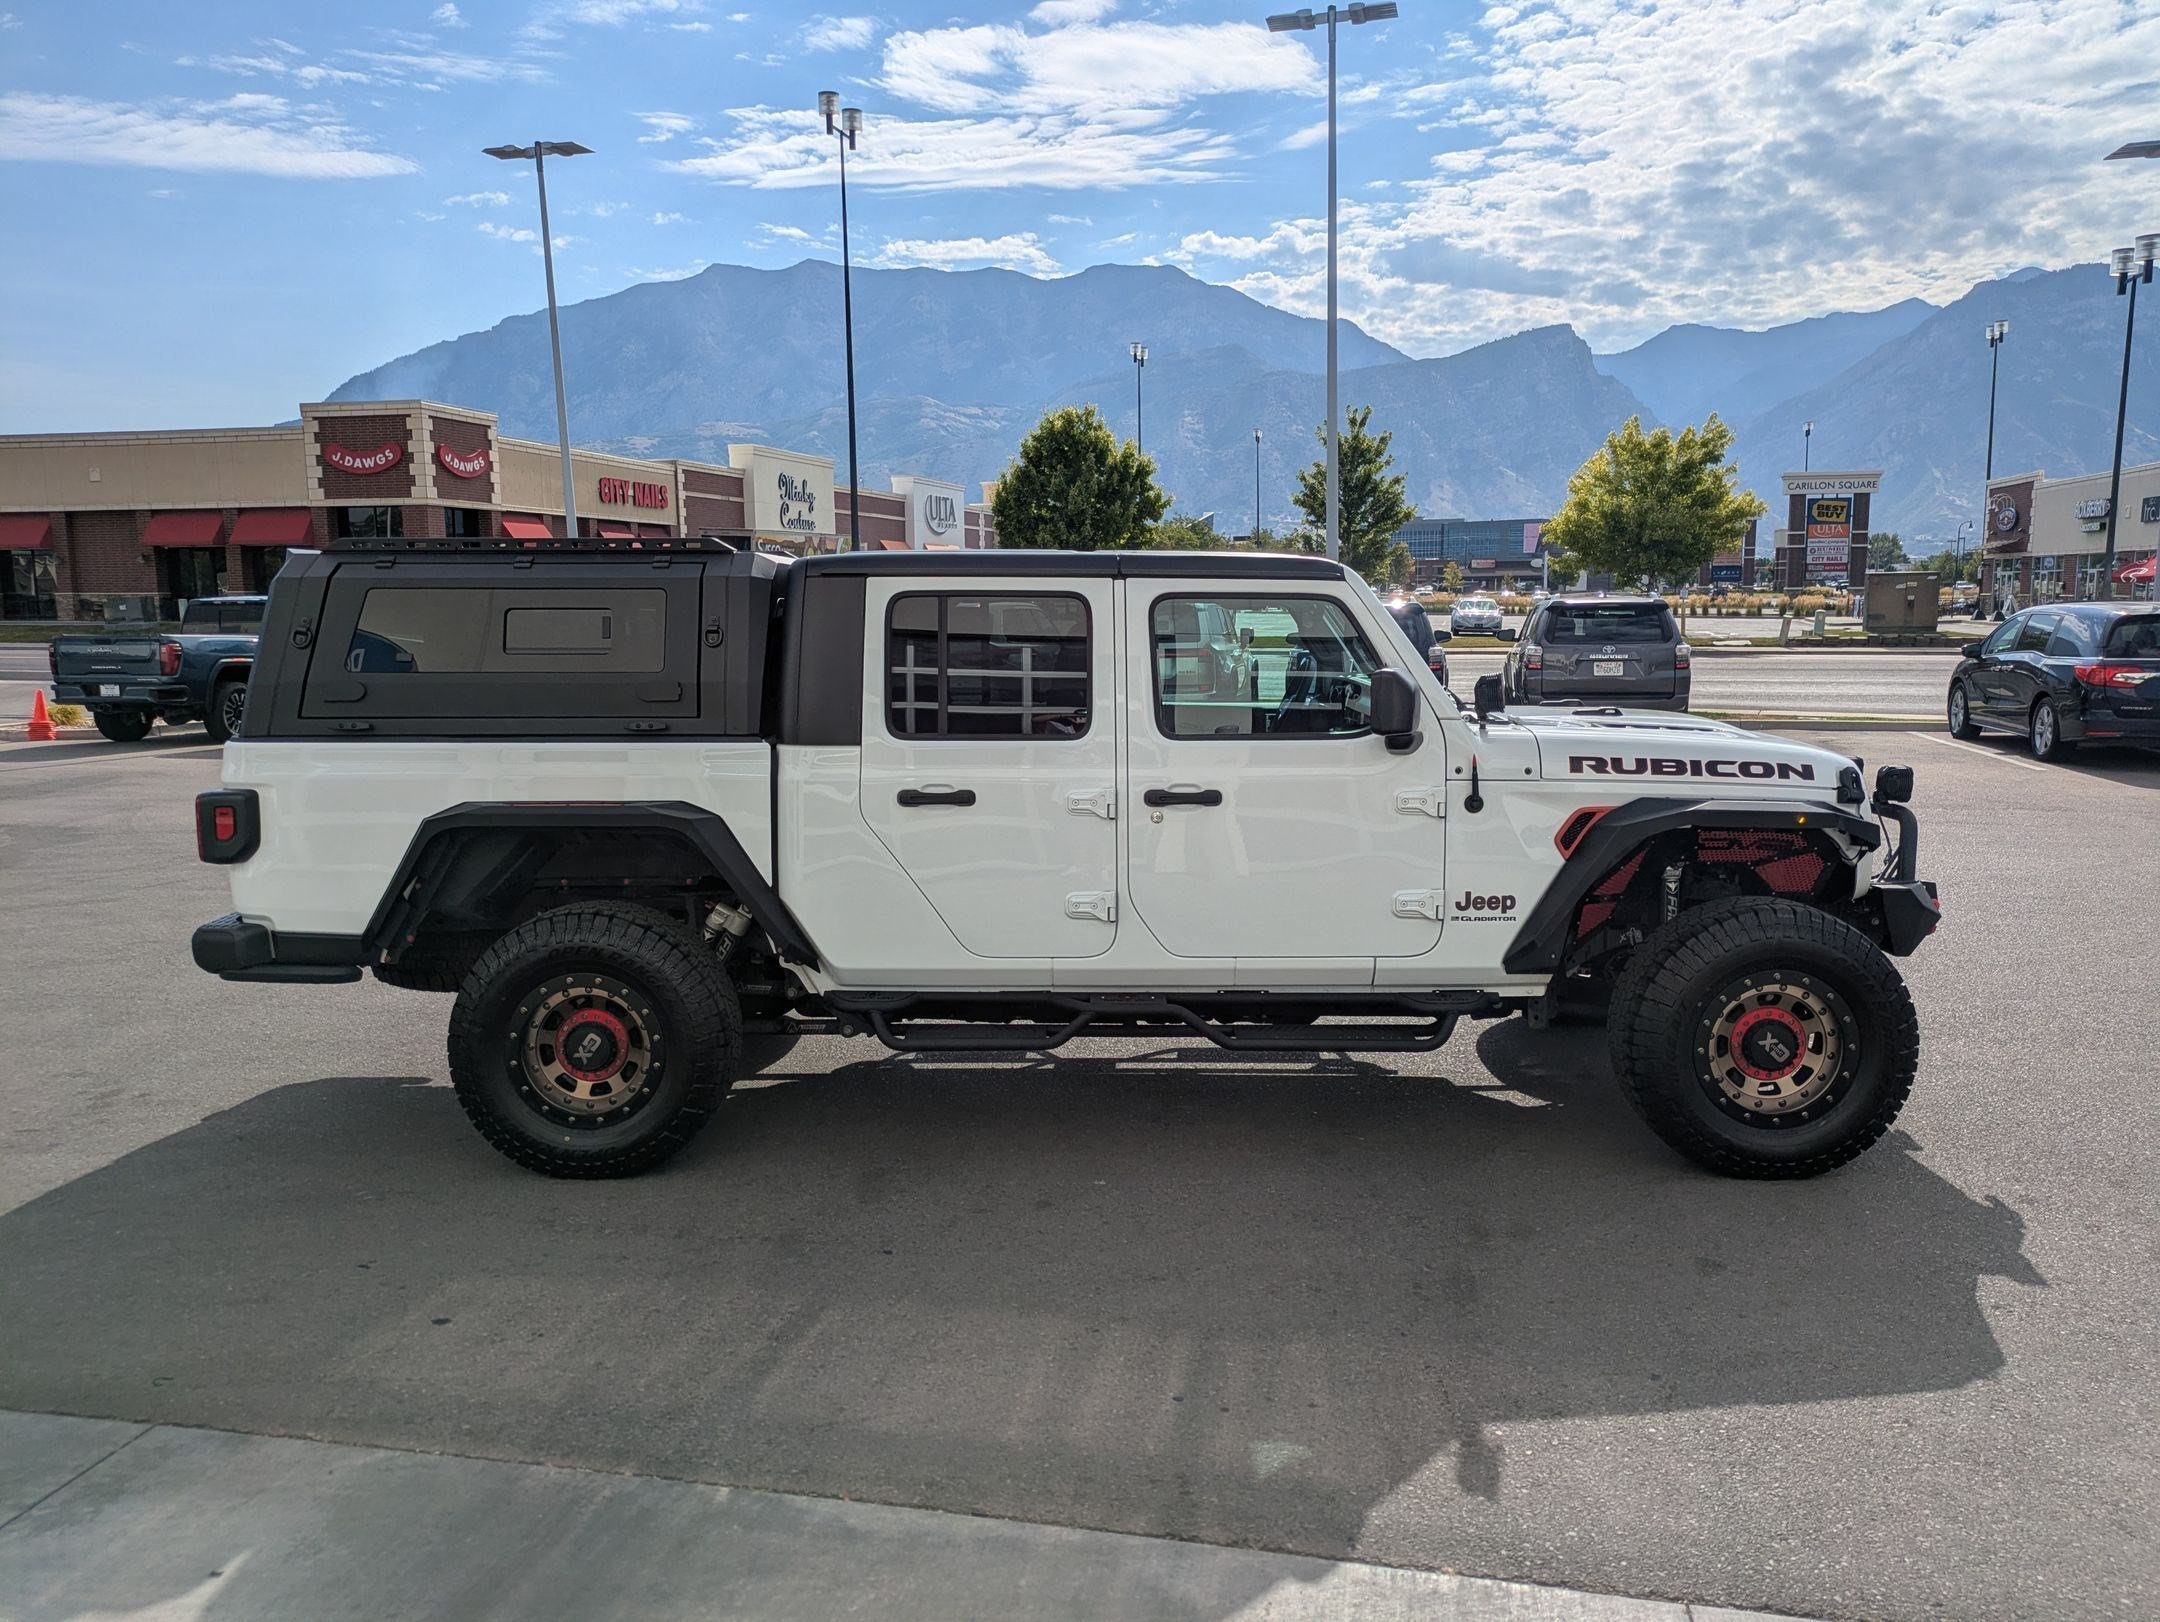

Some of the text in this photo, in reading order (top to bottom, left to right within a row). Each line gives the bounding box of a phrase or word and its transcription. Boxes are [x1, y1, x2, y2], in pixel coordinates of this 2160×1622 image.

[332, 449, 394, 468] J.DAWGS
[445, 455, 485, 472] J.DAWGS
[599, 477, 668, 508] CITY NAILS
[778, 472, 816, 513] Minky
[1787, 480, 1878, 490] CARILLON SQUARE
[780, 501, 816, 531] Couture
[929, 494, 957, 522] ULTA
[1816, 504, 1846, 512] BEST
[1817, 524, 1843, 533] ULTA
[1568, 755, 1816, 780] RUBICON
[1455, 891, 1516, 914] Jeep
